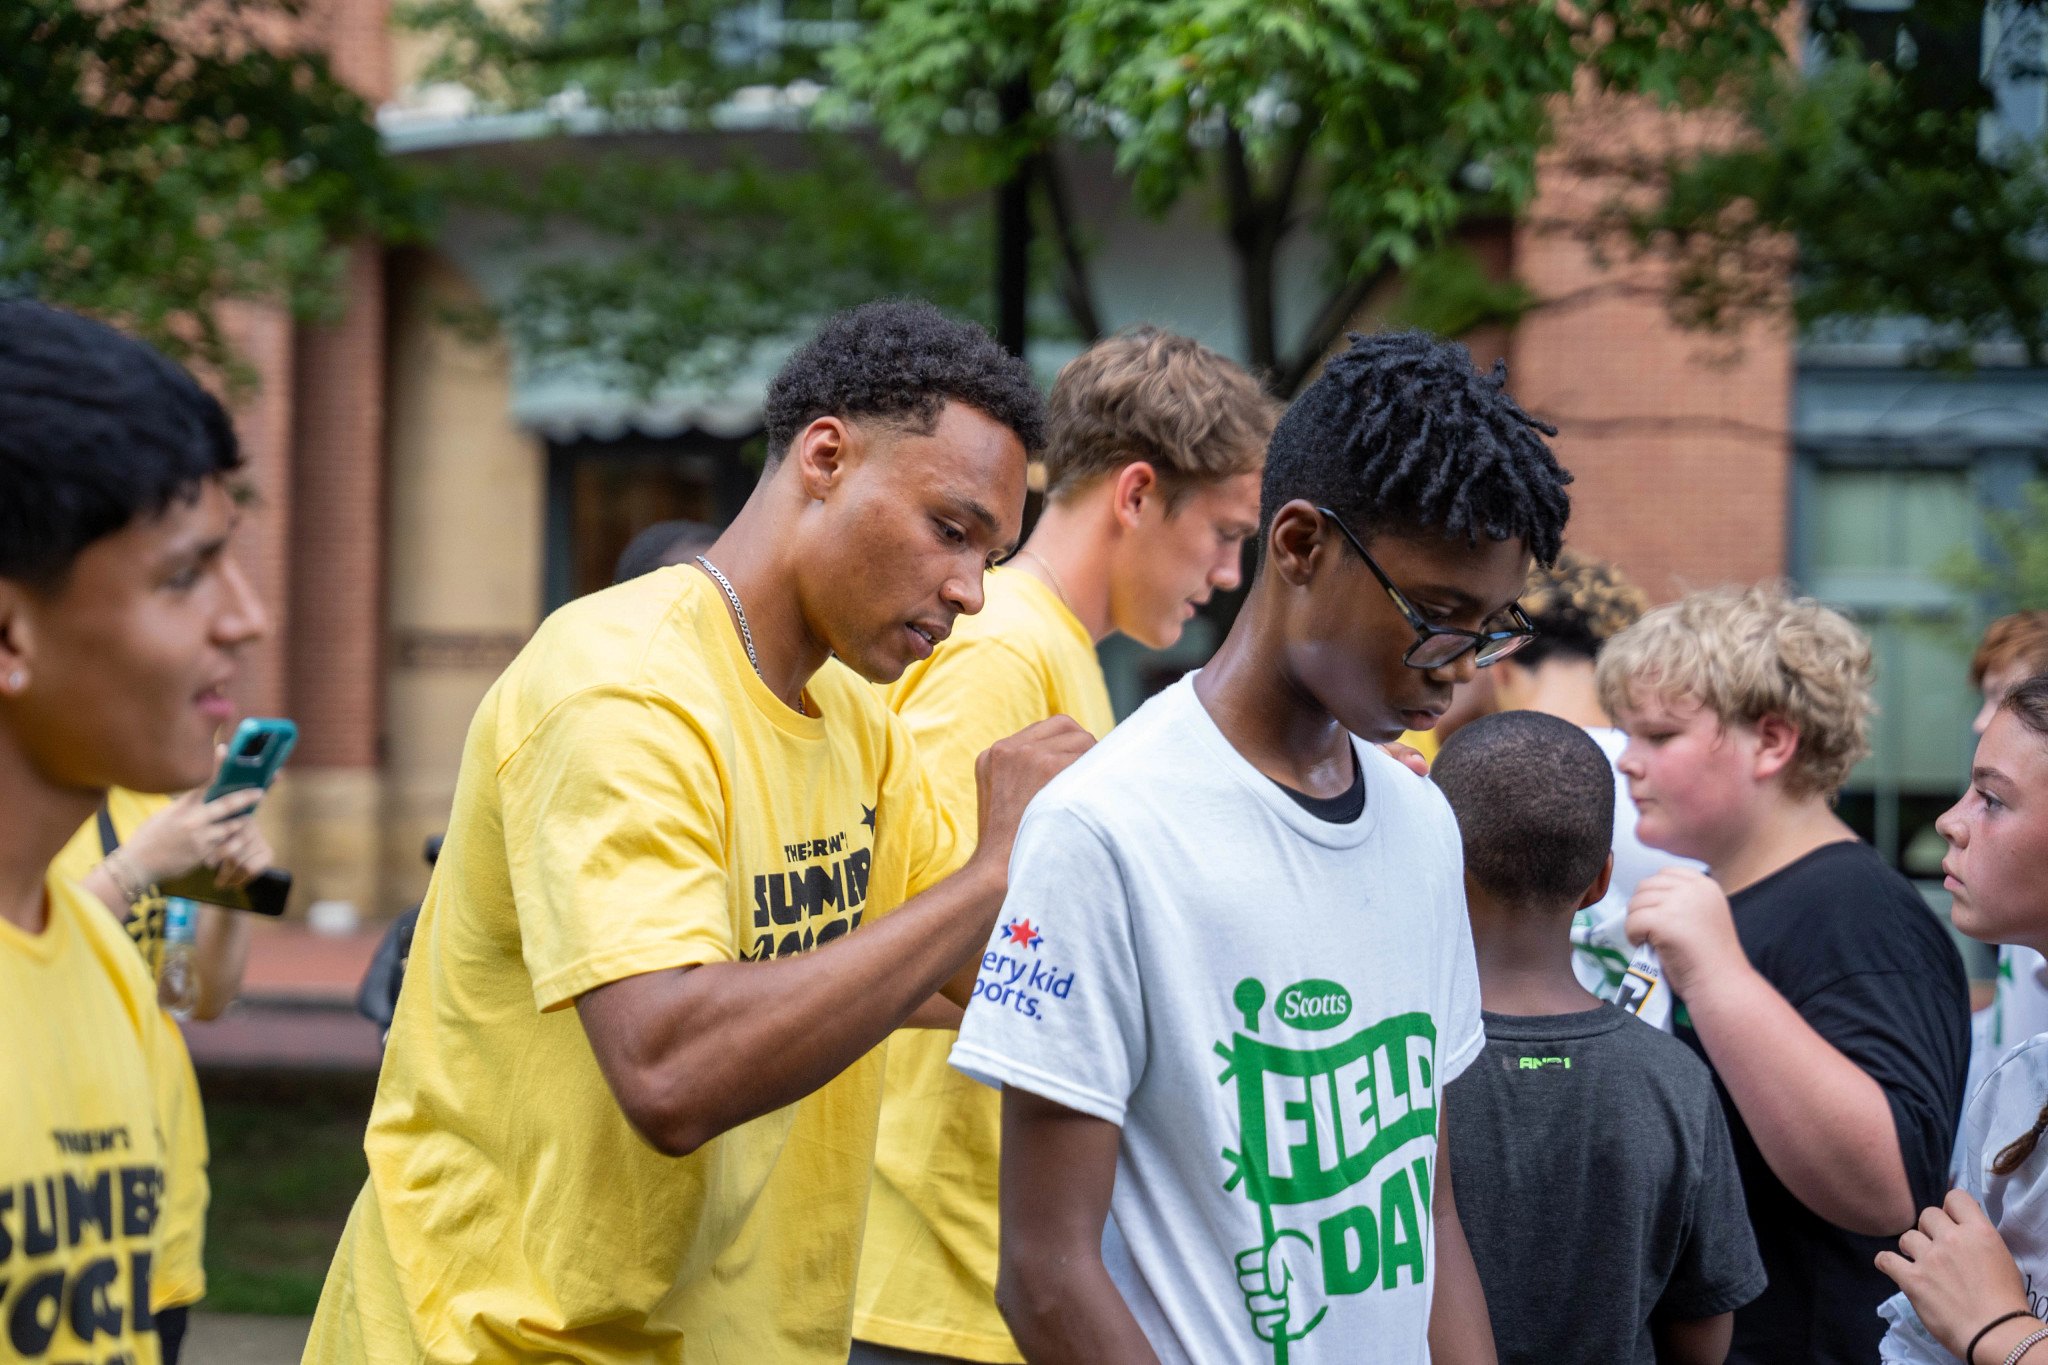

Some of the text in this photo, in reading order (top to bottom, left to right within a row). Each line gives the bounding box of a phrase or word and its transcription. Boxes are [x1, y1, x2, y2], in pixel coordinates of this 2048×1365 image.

[784, 843, 807, 862] THE
[1027, 959, 1075, 999] kid
[1284, 989, 1348, 1019] Scotts
[1262, 1034, 1433, 1180] FIELD
